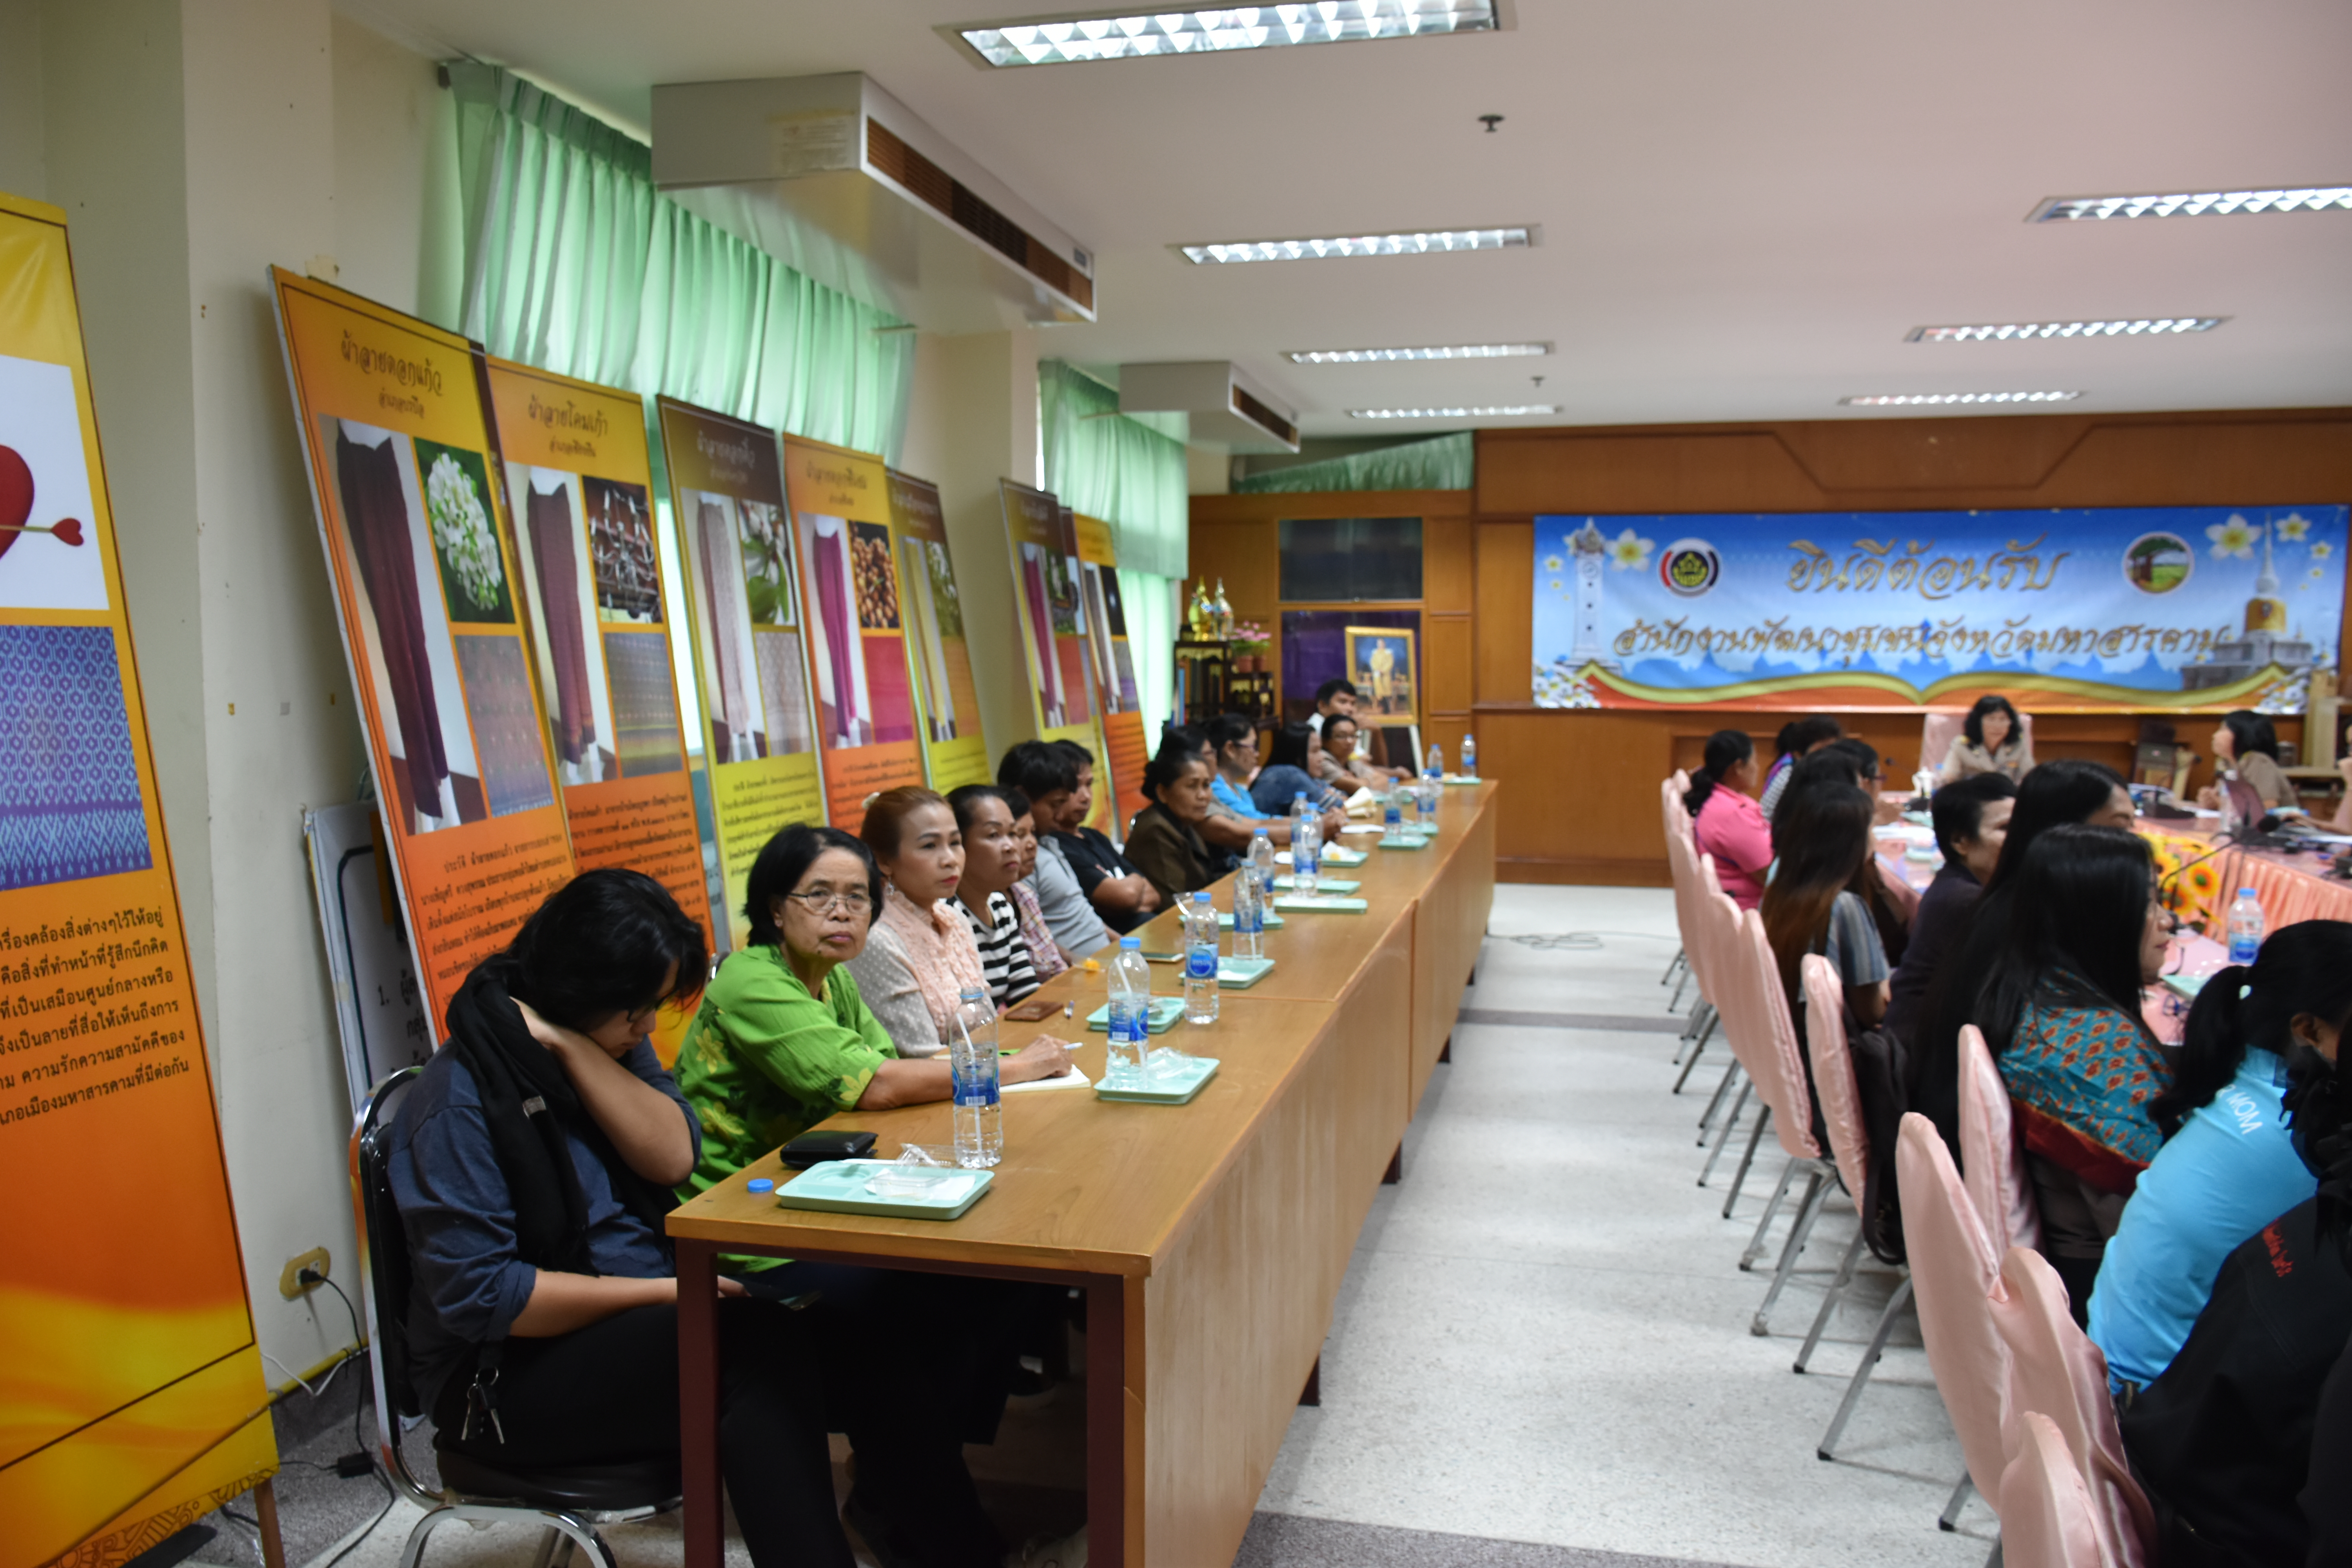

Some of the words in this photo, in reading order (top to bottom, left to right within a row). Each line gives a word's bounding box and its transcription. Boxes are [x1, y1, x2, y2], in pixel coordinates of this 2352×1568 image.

[1787, 531, 2070, 601] ยินดีต้อนรับ
[1612, 615, 2232, 668] สำนักงานพัฒนาชุมชนจังหวัดมหาสารคาม
